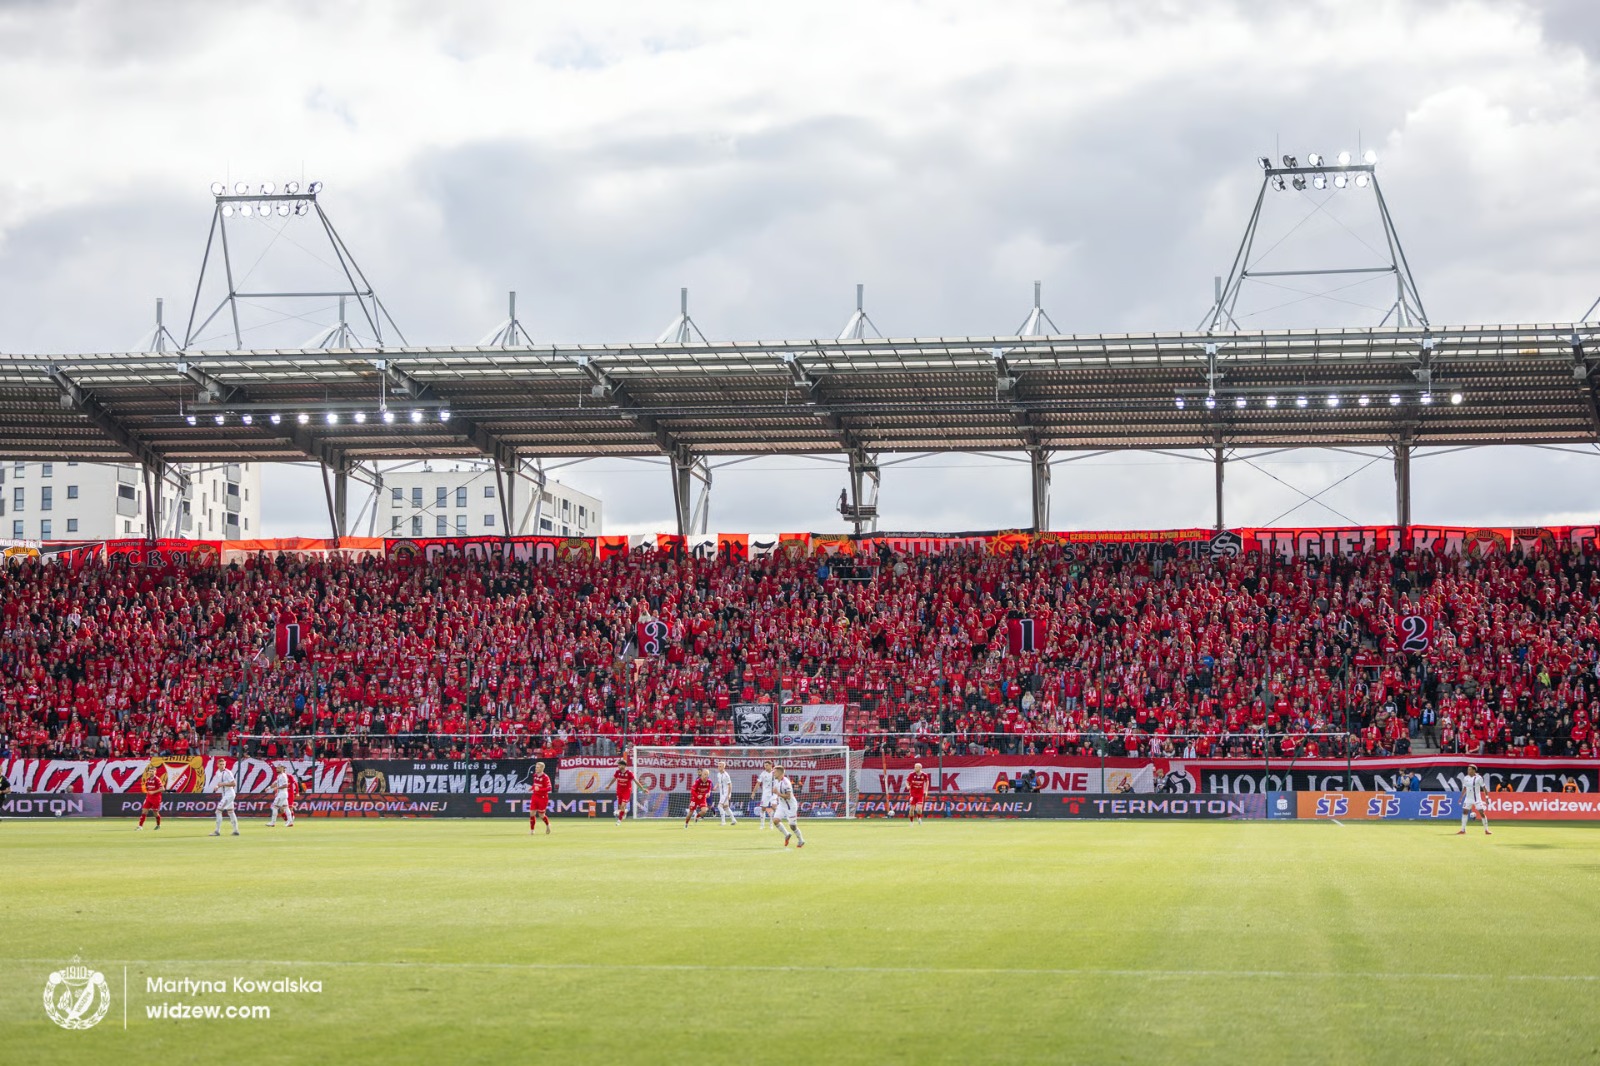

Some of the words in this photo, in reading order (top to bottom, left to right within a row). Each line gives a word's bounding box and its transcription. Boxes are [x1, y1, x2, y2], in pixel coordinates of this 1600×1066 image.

[286, 623, 300, 659] 1
[645, 620, 669, 656] 3
[1019, 618, 1036, 655] 1
[1401, 615, 1429, 651] 2
[561, 756, 624, 768] ROBOTNICZ
[388, 775, 466, 793] WIDZEW
[470, 769, 518, 793] ŁÓDŹ
[177, 802, 268, 811] PRODCENT
[344, 802, 448, 812] BUDOWLANEJ
[1093, 799, 1245, 813] TERMOTON
[1315, 793, 1349, 817] STS
[1367, 793, 1401, 817] STS
[1418, 793, 1453, 817] STS
